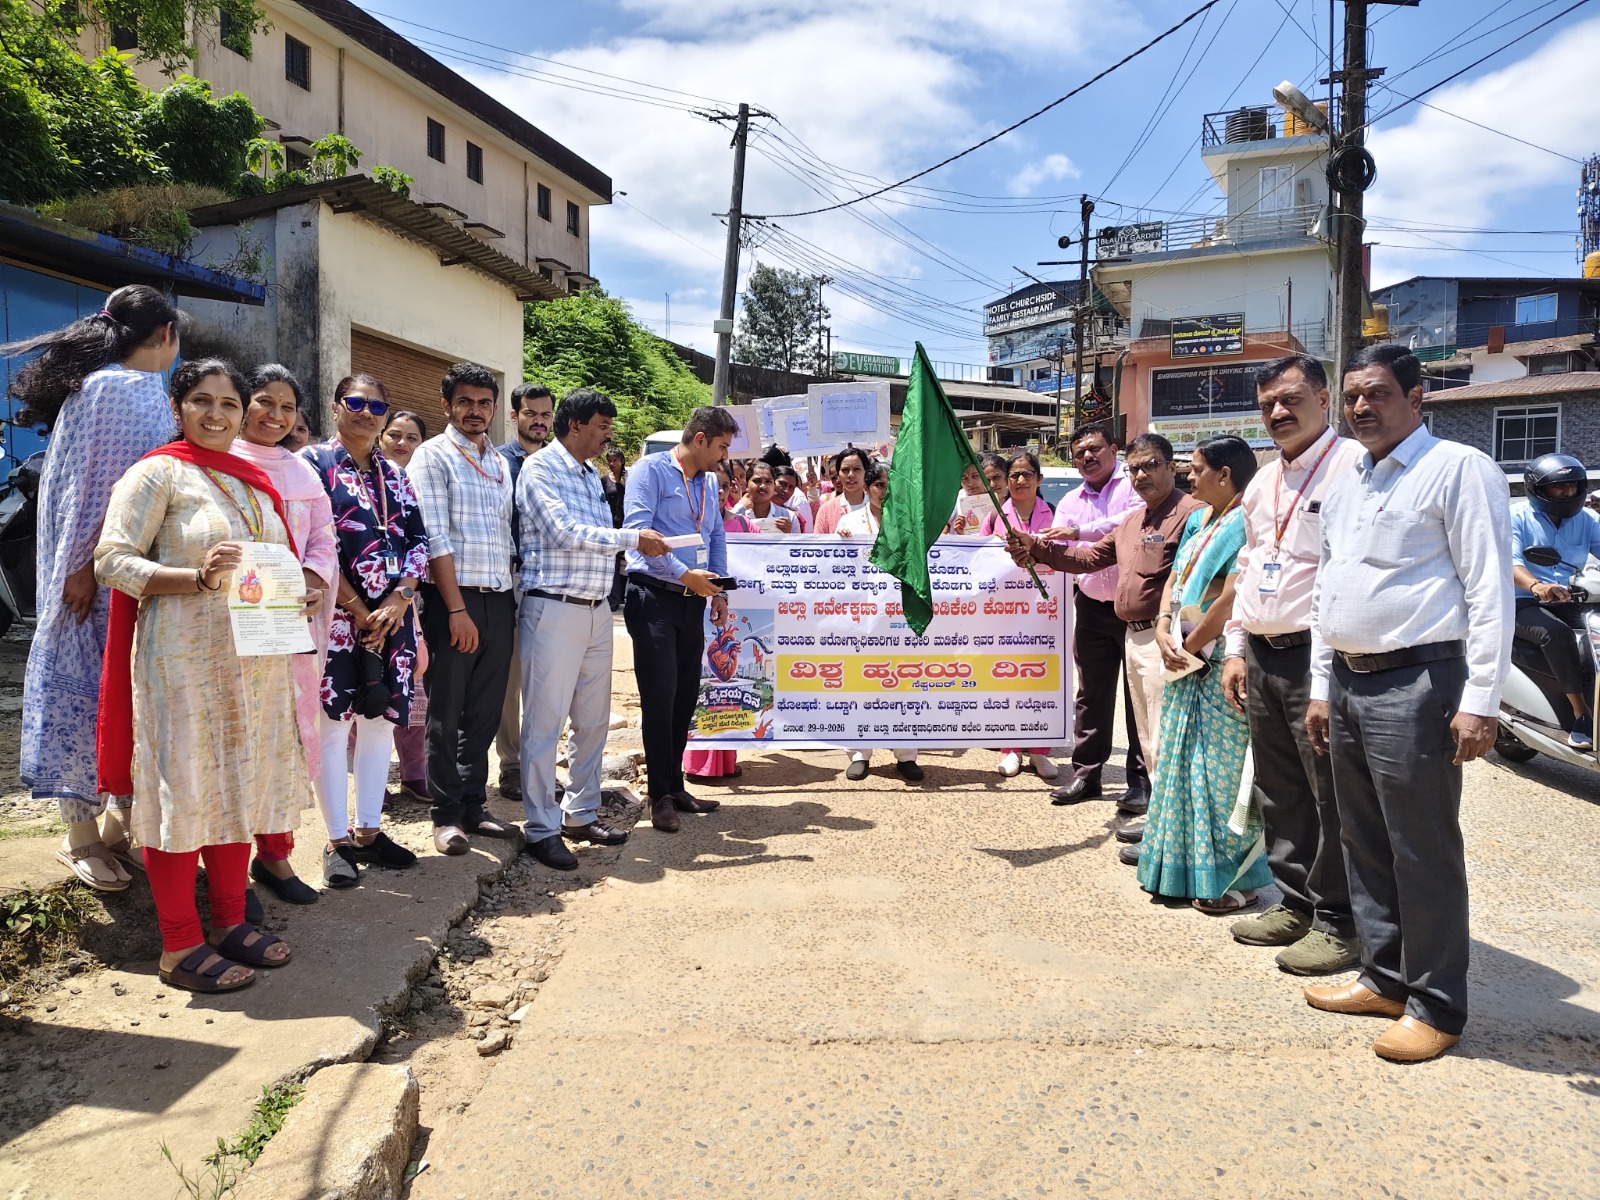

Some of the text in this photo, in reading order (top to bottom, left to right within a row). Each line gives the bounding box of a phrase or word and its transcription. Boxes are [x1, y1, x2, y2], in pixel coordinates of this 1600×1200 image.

[1100, 236, 1129, 245] BEAUTY
[1130, 231, 1161, 241] GARDEN
[987, 291, 1057, 315] HOTEL CHURCHSIDE
[989, 313, 1011, 324] FAMILY
[1012, 302, 1054, 319] RESTAURANT
[849, 353, 864, 371] EV
[863, 355, 895, 365] CHARGING
[863, 363, 895, 374] STATION
[1157, 370, 1198, 380] SHARADAMBA
[1198, 369, 1219, 377] MOTOR
[1219, 367, 1243, 375] DRIVING
[789, 547, 859, 559] ಕರ್ನಾಟಕ
[766, 563, 821, 578] ಜಿಲ್ಲಾಡಳಿತ,
[832, 563, 857, 578] ಜಿಲ್ಲಾ
[770, 579, 798, 595] ಮತ್ತು
[804, 579, 846, 591] ಕುಟುಂಬ
[852, 579, 887, 596] ಕಲ್ಯಾಣ
[932, 577, 973, 591] ಕೊಡಗು
[778, 601, 807, 621] ಜಿಲ್ಲಾ
[813, 597, 878, 624] ಸರ್ವೇಕ್ಷಣಾ
[885, 602, 905, 618] ಘಟ
[983, 598, 1030, 616] ಕೊಡಗು
[1036, 596, 1058, 621] ಜಿಲ್ಲೆ
[777, 634, 815, 647] ತಾಲೂಕು
[819, 632, 900, 653] ಆರೋಗ್ಯಾಧಿಕಾರಿಗಳ
[933, 632, 970, 647] ಮಡಿಕೇರಿ
[973, 634, 995, 648] ಇವರ
[998, 631, 1056, 650] ಸಹಯೋಗದಲ್ಲಿ
[789, 659, 1047, 690] ವಿಶ್ವ ಹೃದಯ ದಿನ
[961, 680, 977, 689] 29
[709, 687, 742, 702] ಹೃದಯ
[743, 692, 761, 709] ದಿನ
[826, 699, 858, 716] ಒಟ್ಟಾಗಿ
[938, 700, 978, 717] ವಿಜ್ಞಾನದ
[983, 697, 1010, 710] ಜೊತೆ
[873, 723, 890, 736] ಜಿಲ್ಲಾ
[1020, 722, 1049, 732] ಮಡಿಕೇರಿ
